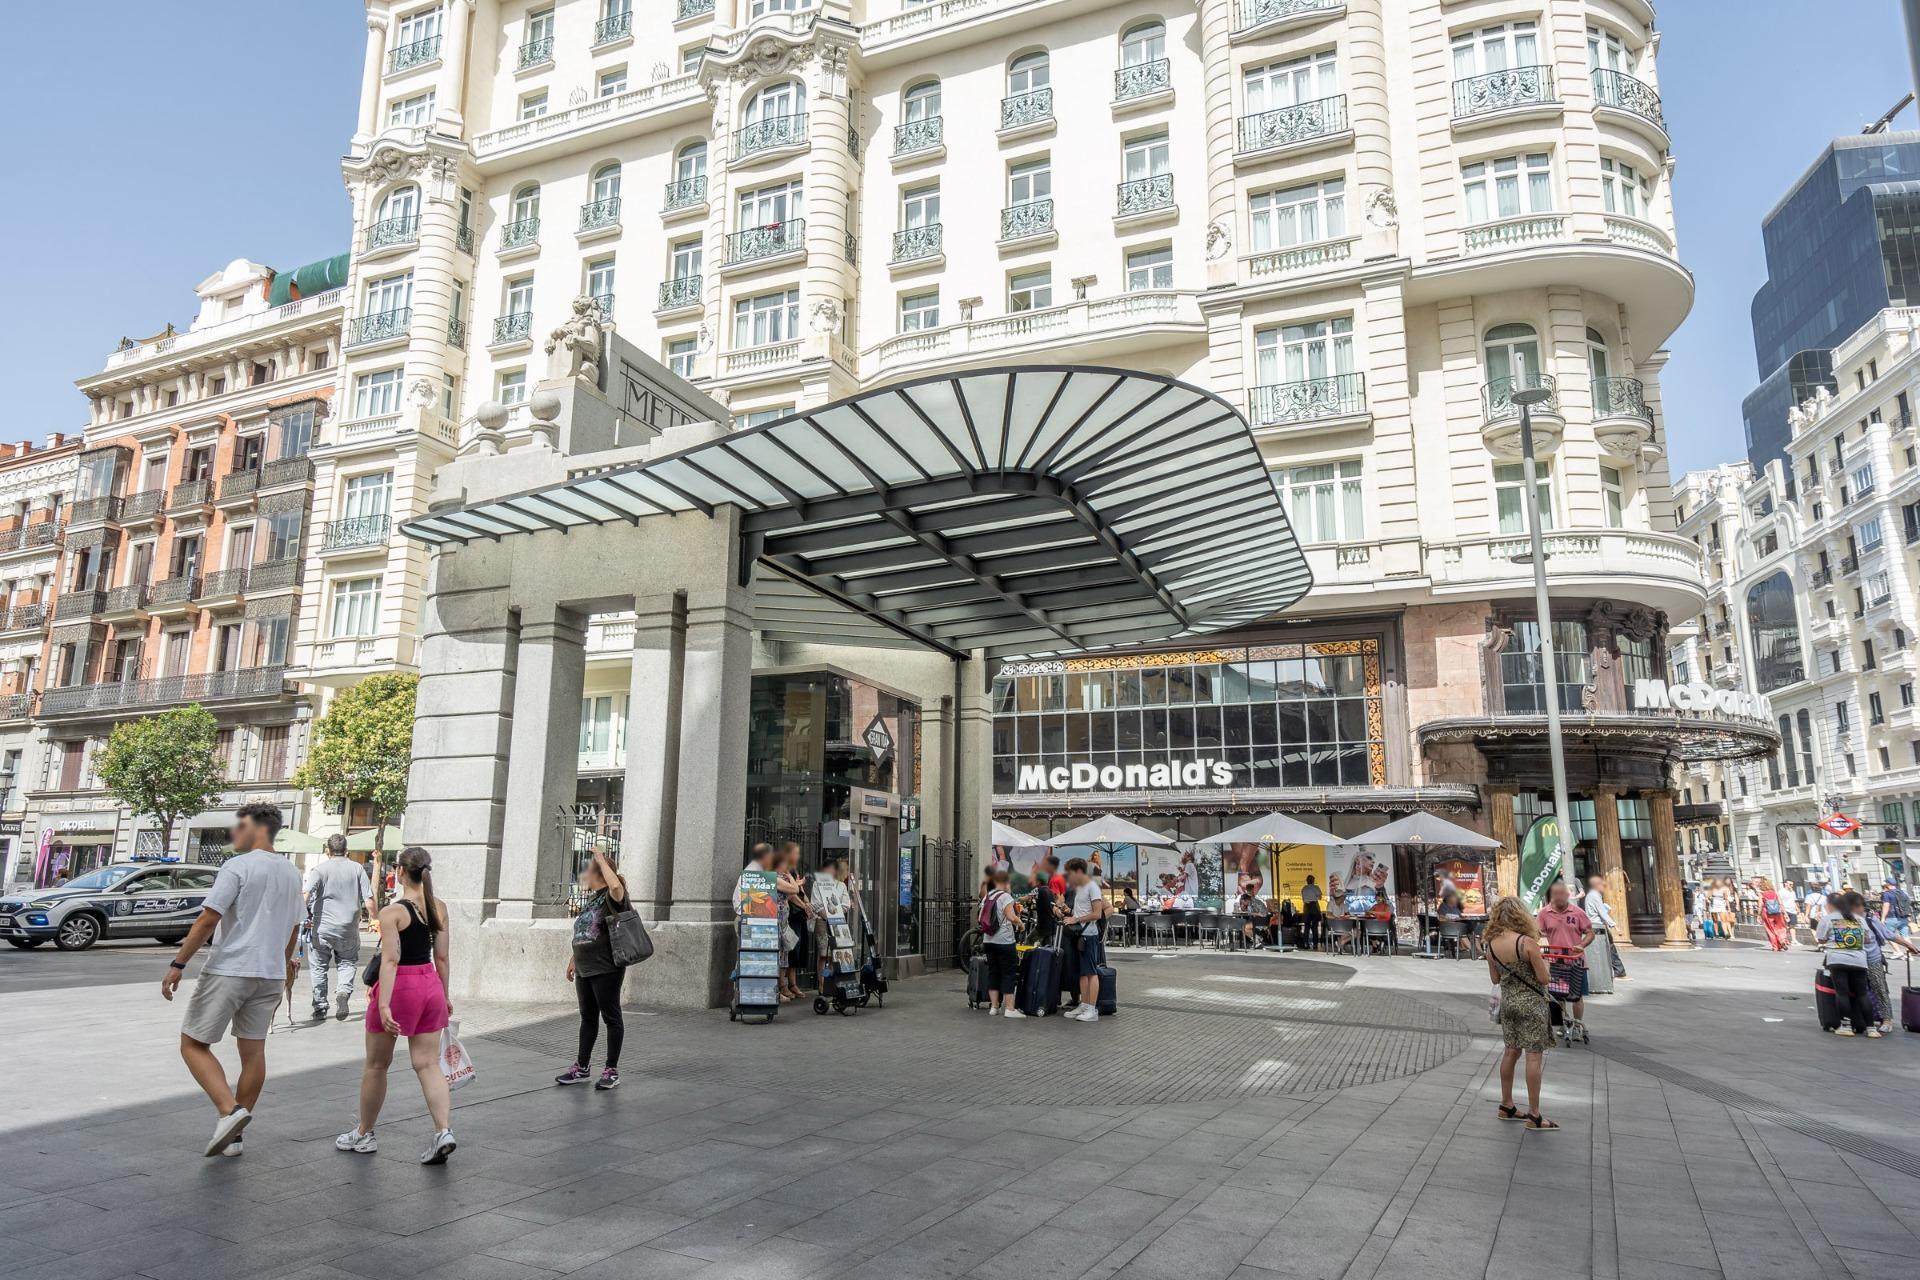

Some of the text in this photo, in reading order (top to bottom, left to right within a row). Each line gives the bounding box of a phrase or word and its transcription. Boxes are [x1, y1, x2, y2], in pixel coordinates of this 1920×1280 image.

[1018, 758, 1233, 790] McDonald's
[60, 820, 95, 829] TACO BELL
